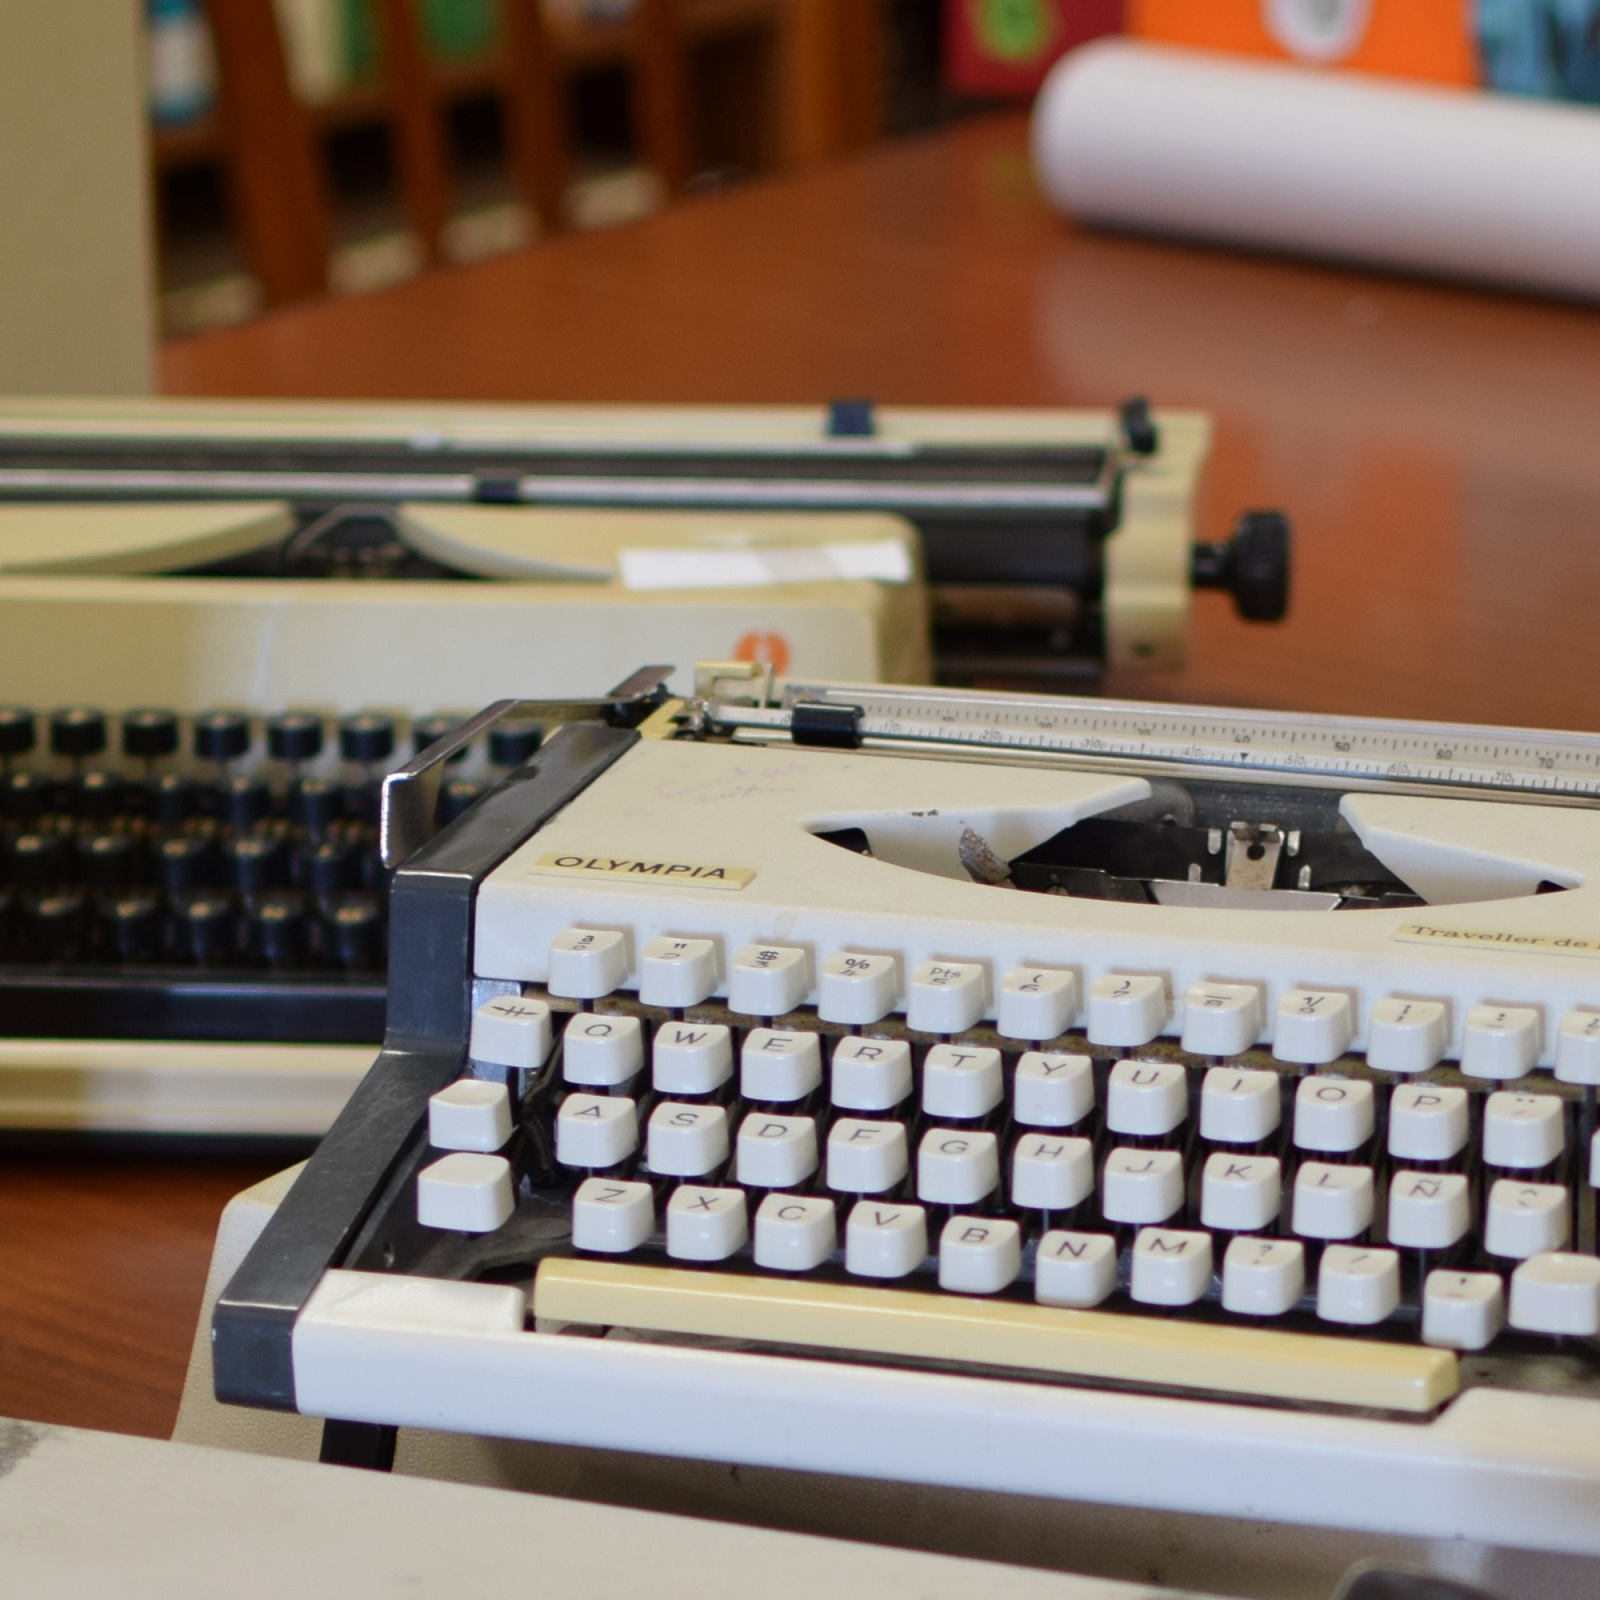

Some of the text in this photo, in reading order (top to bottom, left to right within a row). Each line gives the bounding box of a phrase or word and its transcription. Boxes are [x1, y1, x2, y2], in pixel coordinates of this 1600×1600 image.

[1334, 741, 1351, 752] 50
[1538, 757, 1554, 770] 70
[554, 855, 728, 880] OLYMPIA
[1412, 925, 1544, 946] Traveller
[1554, 938, 1587, 948] de
[845, 957, 870, 970] %
[585, 1024, 612, 1036] Q
[675, 1031, 707, 1044] W
[763, 1038, 792, 1049] E
[854, 1046, 883, 1060] R
[952, 1054, 975, 1067] T
[1042, 1062, 1066, 1075] Y
[1131, 1070, 1159, 1083] U
[1316, 1088, 1347, 1100] O
[1413, 1095, 1441, 1107] P
[573, 1104, 1442, 1197] A S D F G H J K L Ñ
[595, 1188, 626, 1202] Z
[687, 1195, 719, 1210] X
[778, 1206, 806, 1219] C
[875, 1212, 899, 1226] V
[960, 1227, 989, 1242] B
[1057, 1241, 1087, 1257] N
[1149, 1237, 1188, 1254] M
